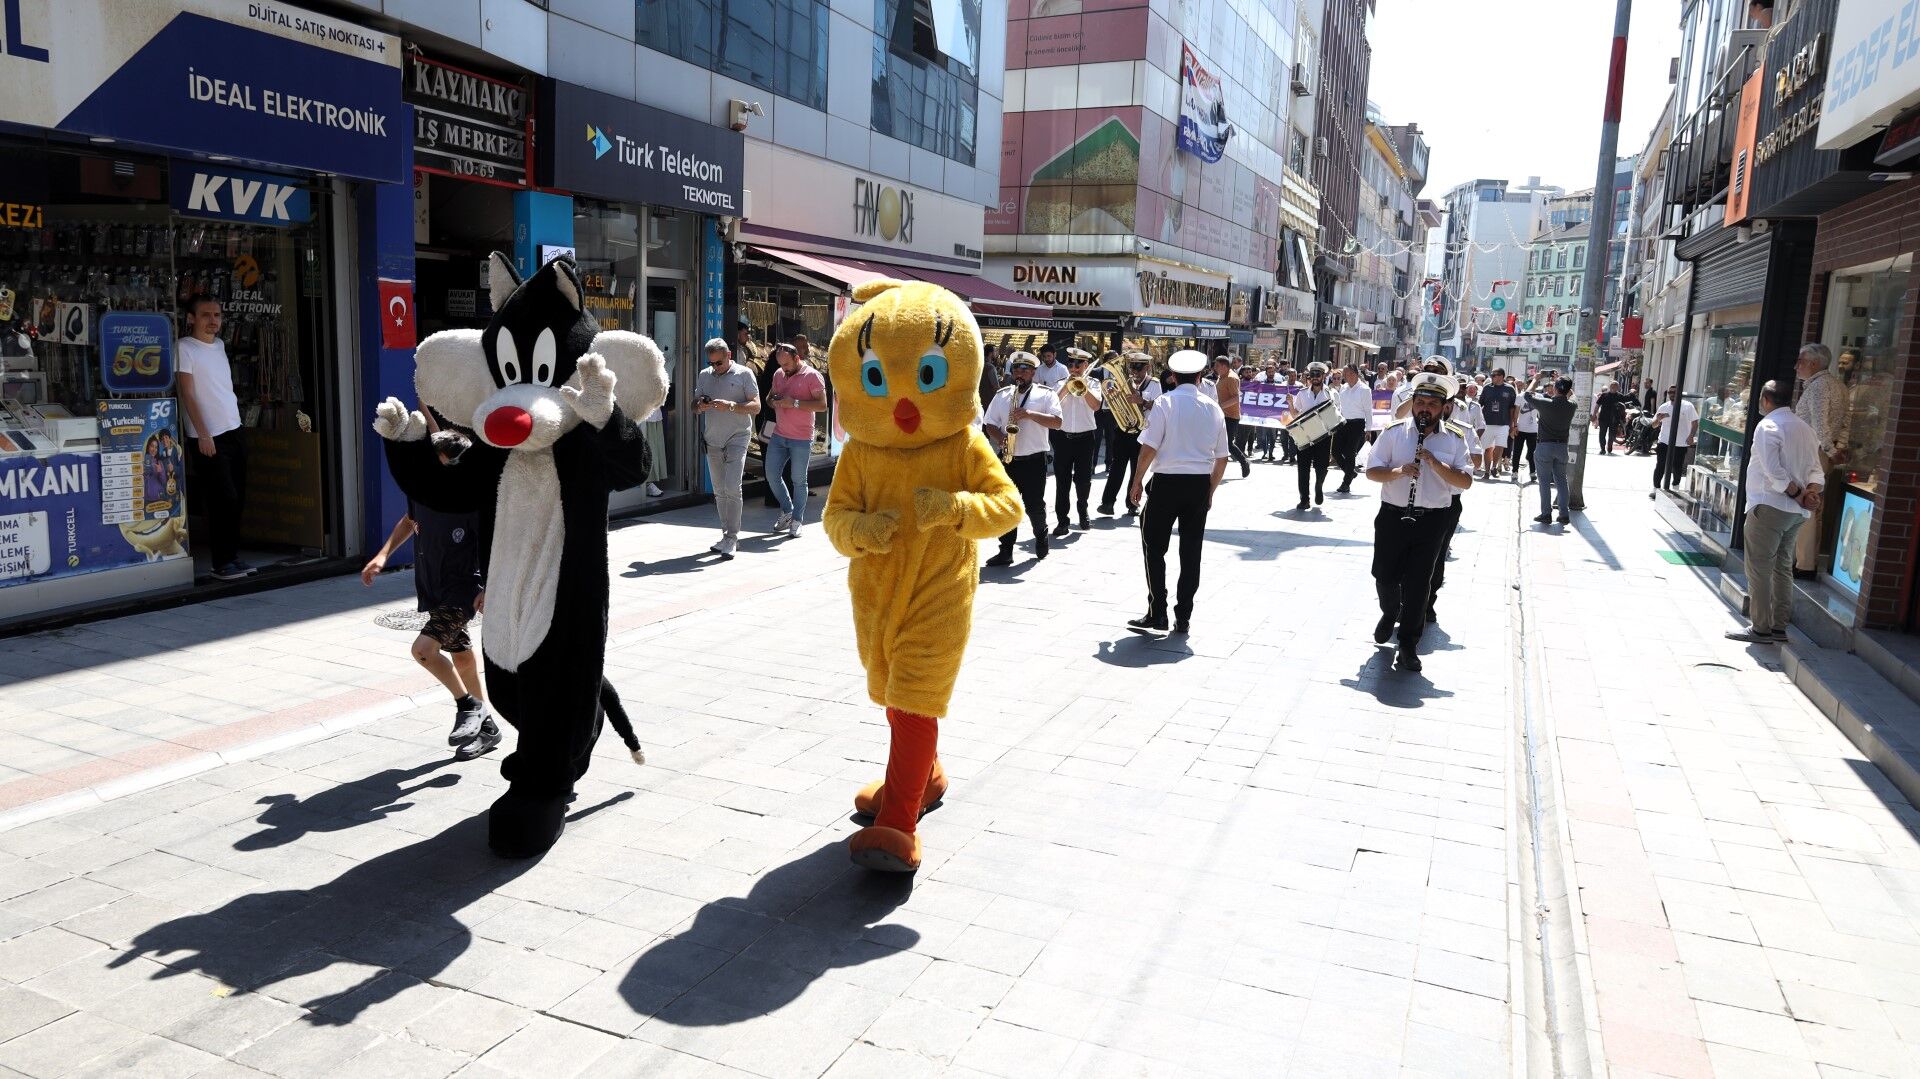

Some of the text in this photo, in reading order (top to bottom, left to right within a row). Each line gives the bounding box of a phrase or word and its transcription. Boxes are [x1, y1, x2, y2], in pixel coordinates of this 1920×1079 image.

[248, 3, 292, 28] DİJİTAL
[295, 17, 326, 41] SATIŞ
[328, 27, 375, 51] NOKTASI
[188, 66, 387, 137] İDEAL ELEKTRONİK
[415, 60, 527, 126] KAYMAKÇI
[417, 110, 438, 148] İŞ
[452, 159, 495, 178] NO:69
[615, 135, 723, 183] Türk Telekom
[187, 172, 297, 221] KVK
[683, 184, 735, 210] TEKNOTEL
[595, 275, 605, 288] EL
[1013, 259, 1077, 284] DİVAN
[585, 295, 634, 310] EFONLARINIZ
[113, 326, 149, 335] TURKCELL
[1018, 318, 1075, 330] KUYUMCULUK
[113, 345, 162, 377] 5G
[150, 400, 171, 420] 5G
[66, 507, 77, 554] TURKCELL
